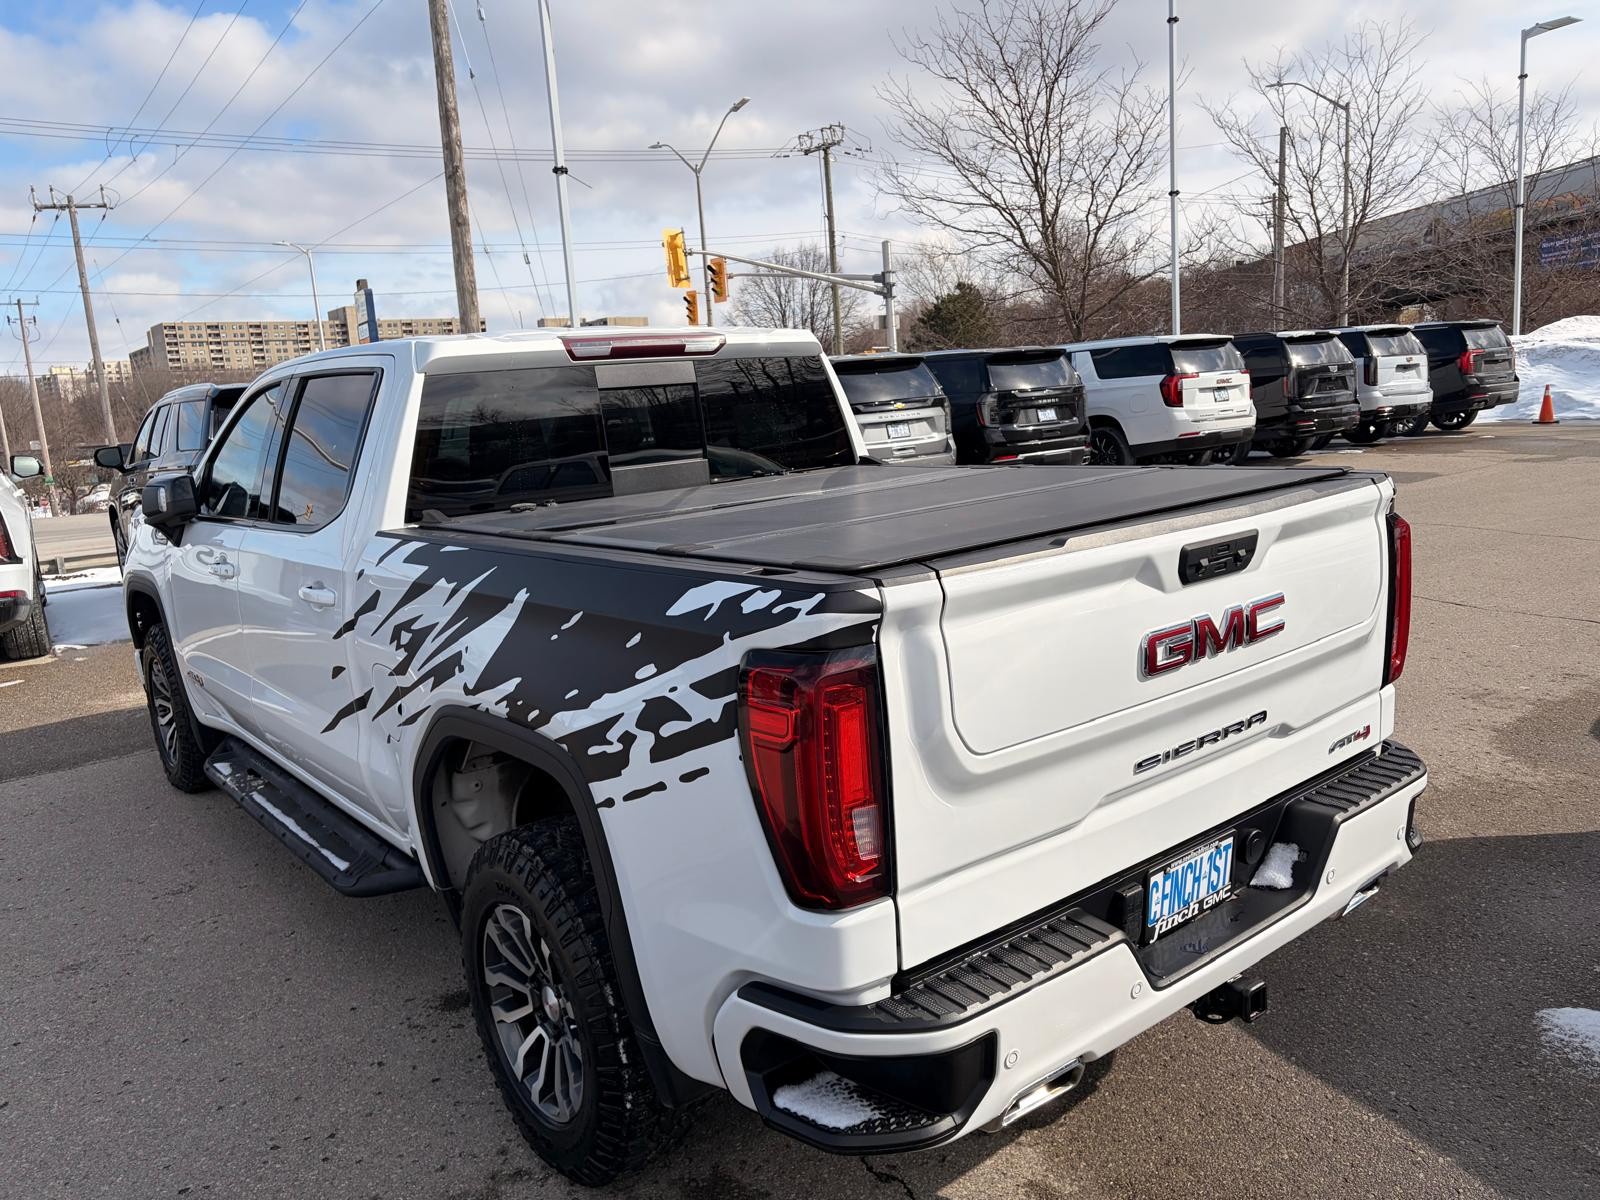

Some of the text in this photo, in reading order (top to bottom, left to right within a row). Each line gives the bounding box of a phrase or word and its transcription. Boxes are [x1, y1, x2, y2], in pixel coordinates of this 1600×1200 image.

[1137, 591, 1286, 683] GMC
[1133, 709, 1268, 775] SIERRA
[1328, 724, 1371, 755] AT4
[1149, 884, 1232, 944] finch GMC
